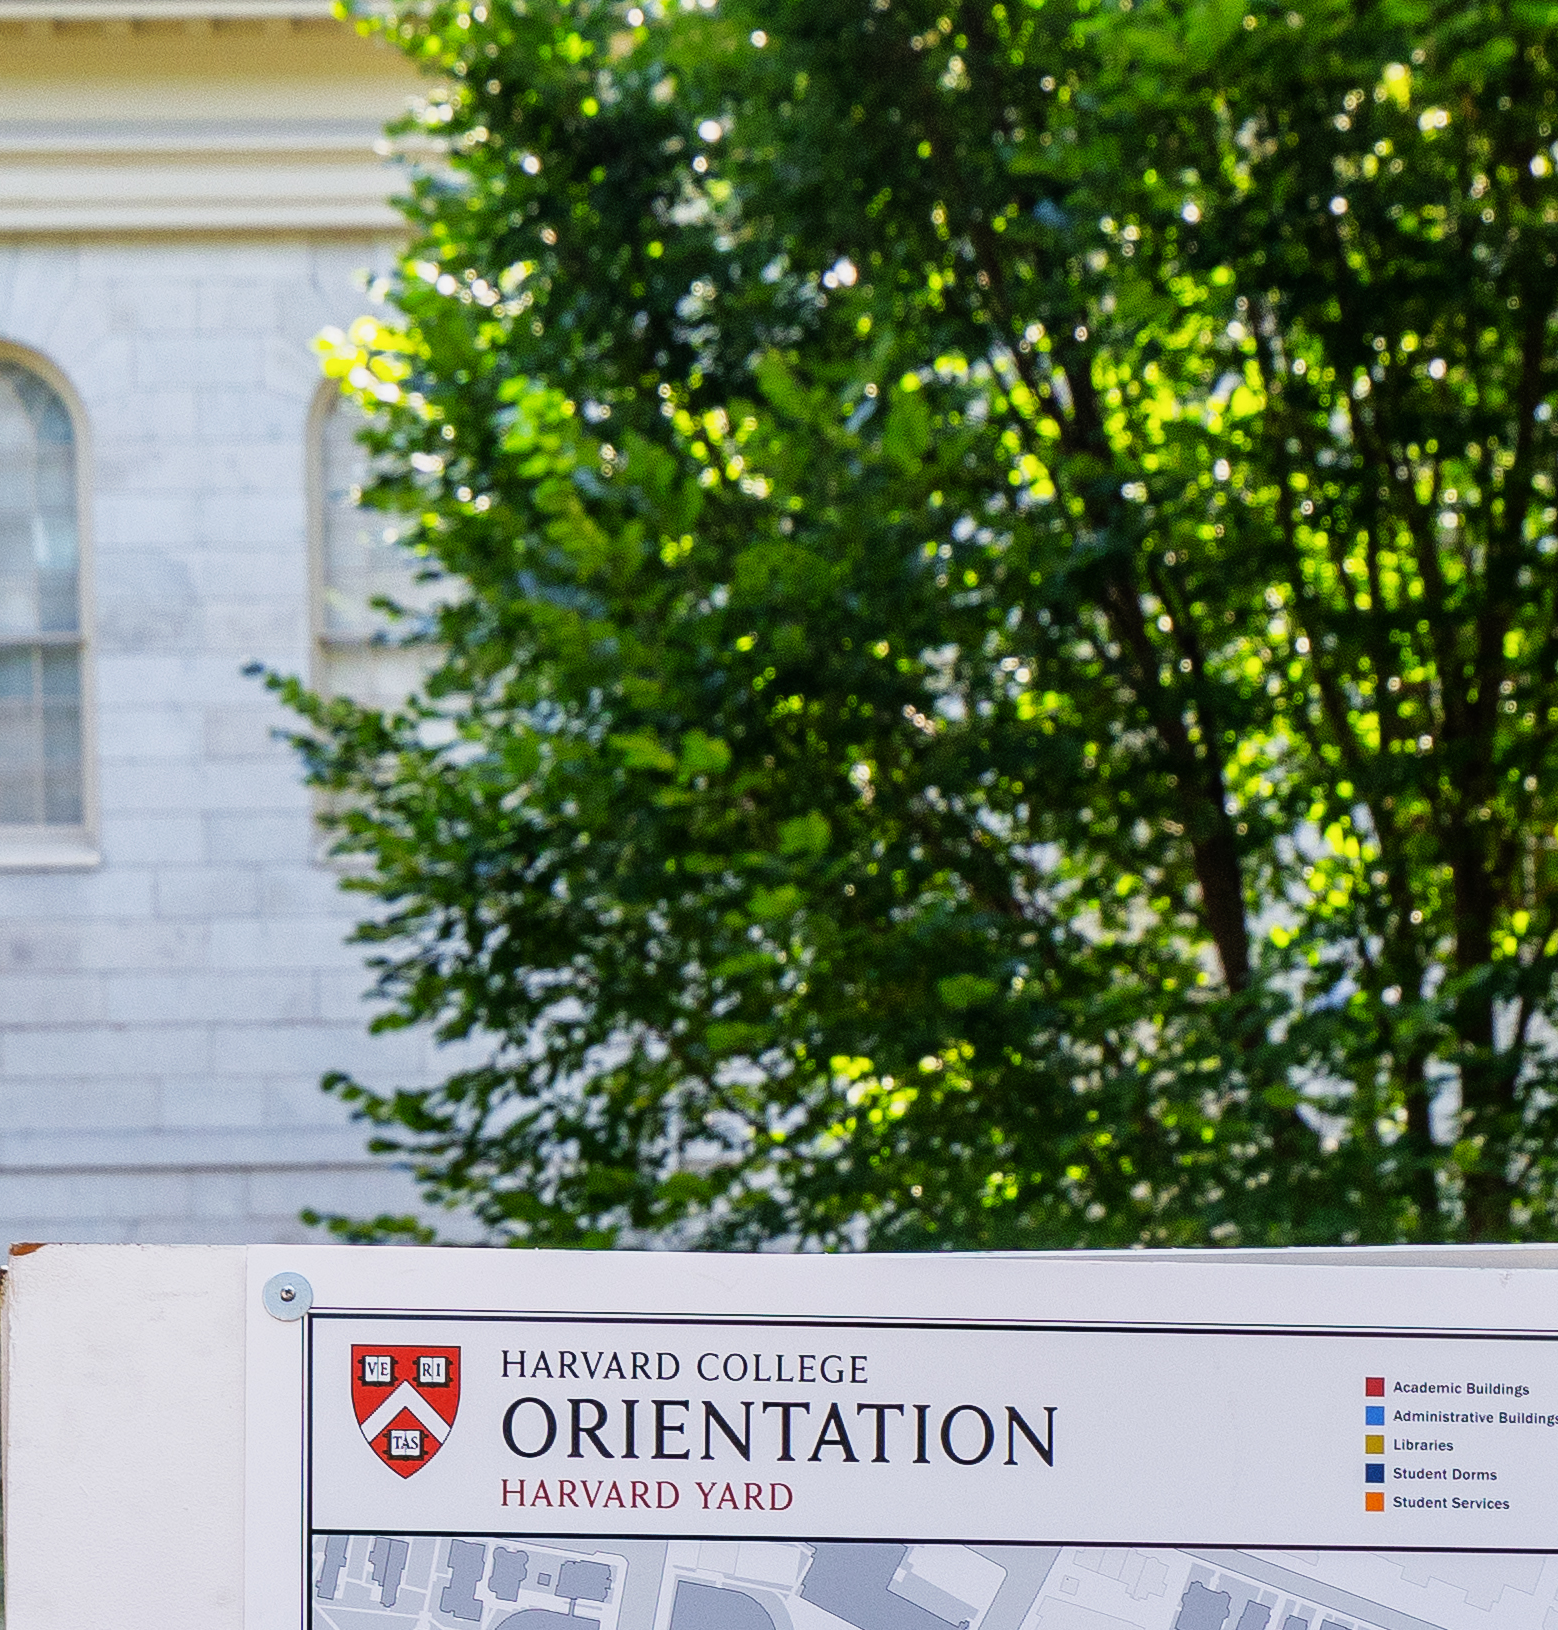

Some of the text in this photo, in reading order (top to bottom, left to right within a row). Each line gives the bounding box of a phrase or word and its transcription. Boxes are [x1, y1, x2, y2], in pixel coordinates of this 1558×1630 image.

[501, 1350, 868, 1384] HARVARD COLLEGE
[1393, 1381, 1530, 1398] Academic Buildings
[1393, 1410, 1494, 1423] Administrative
[502, 1396, 1058, 1467] ORIENTATION
[392, 1434, 420, 1451] TAS
[1393, 1439, 1454, 1451] Libraries
[1393, 1467, 1497, 1481] Student Dorms
[501, 1479, 793, 1511] HARVARD YARD
[1393, 1496, 1510, 1510] Student Services
